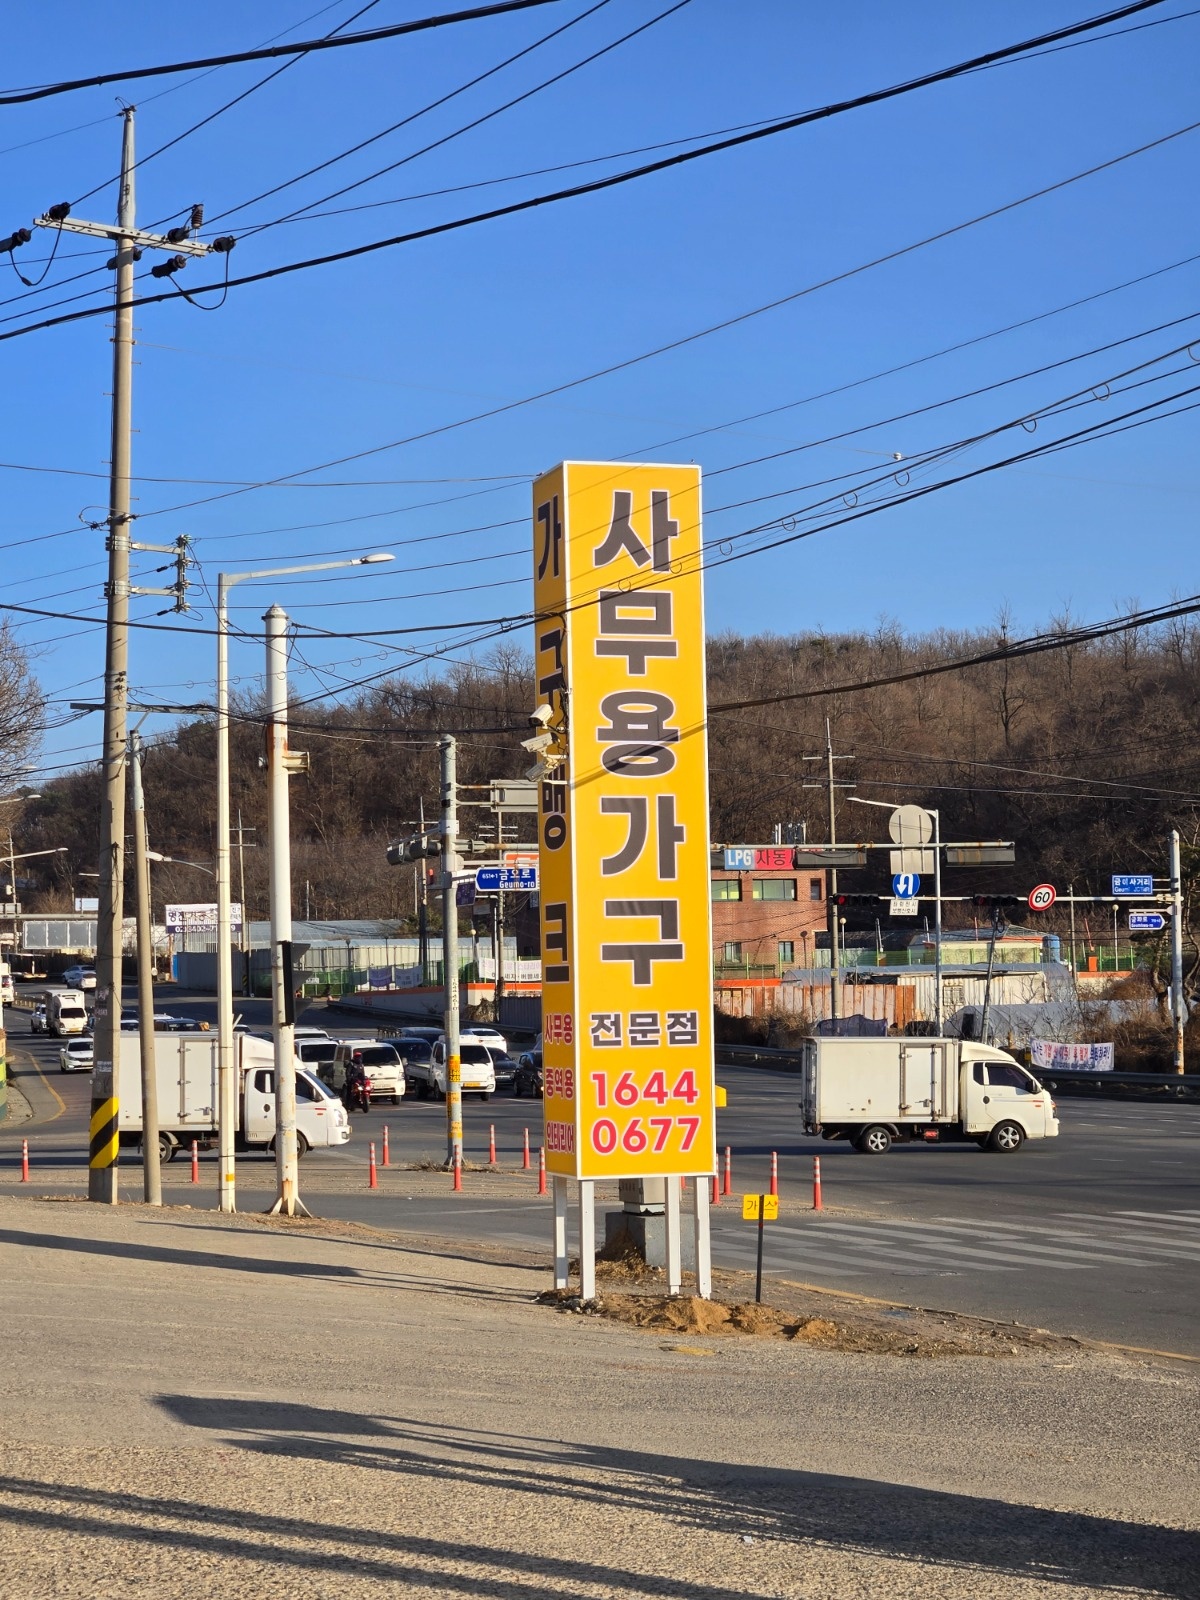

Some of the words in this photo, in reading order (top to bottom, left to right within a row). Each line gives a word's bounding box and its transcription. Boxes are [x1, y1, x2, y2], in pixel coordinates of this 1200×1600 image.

[593, 489, 687, 987] 사무용가구
[728, 849, 752, 866] LPG
[756, 849, 794, 866] 자동
[499, 869, 532, 881] 금오로
[499, 881, 535, 889] Geumo-ro
[1035, 891, 1051, 904] 60
[544, 1013, 573, 1045] 사무용
[589, 1010, 699, 1048] 전문점
[545, 1066, 574, 1100] 중역용
[591, 1069, 699, 1107] 1644
[546, 1121, 575, 1155] 인테리어
[591, 1116, 701, 1155] 0677
[746, 1201, 774, 1211] 가스
